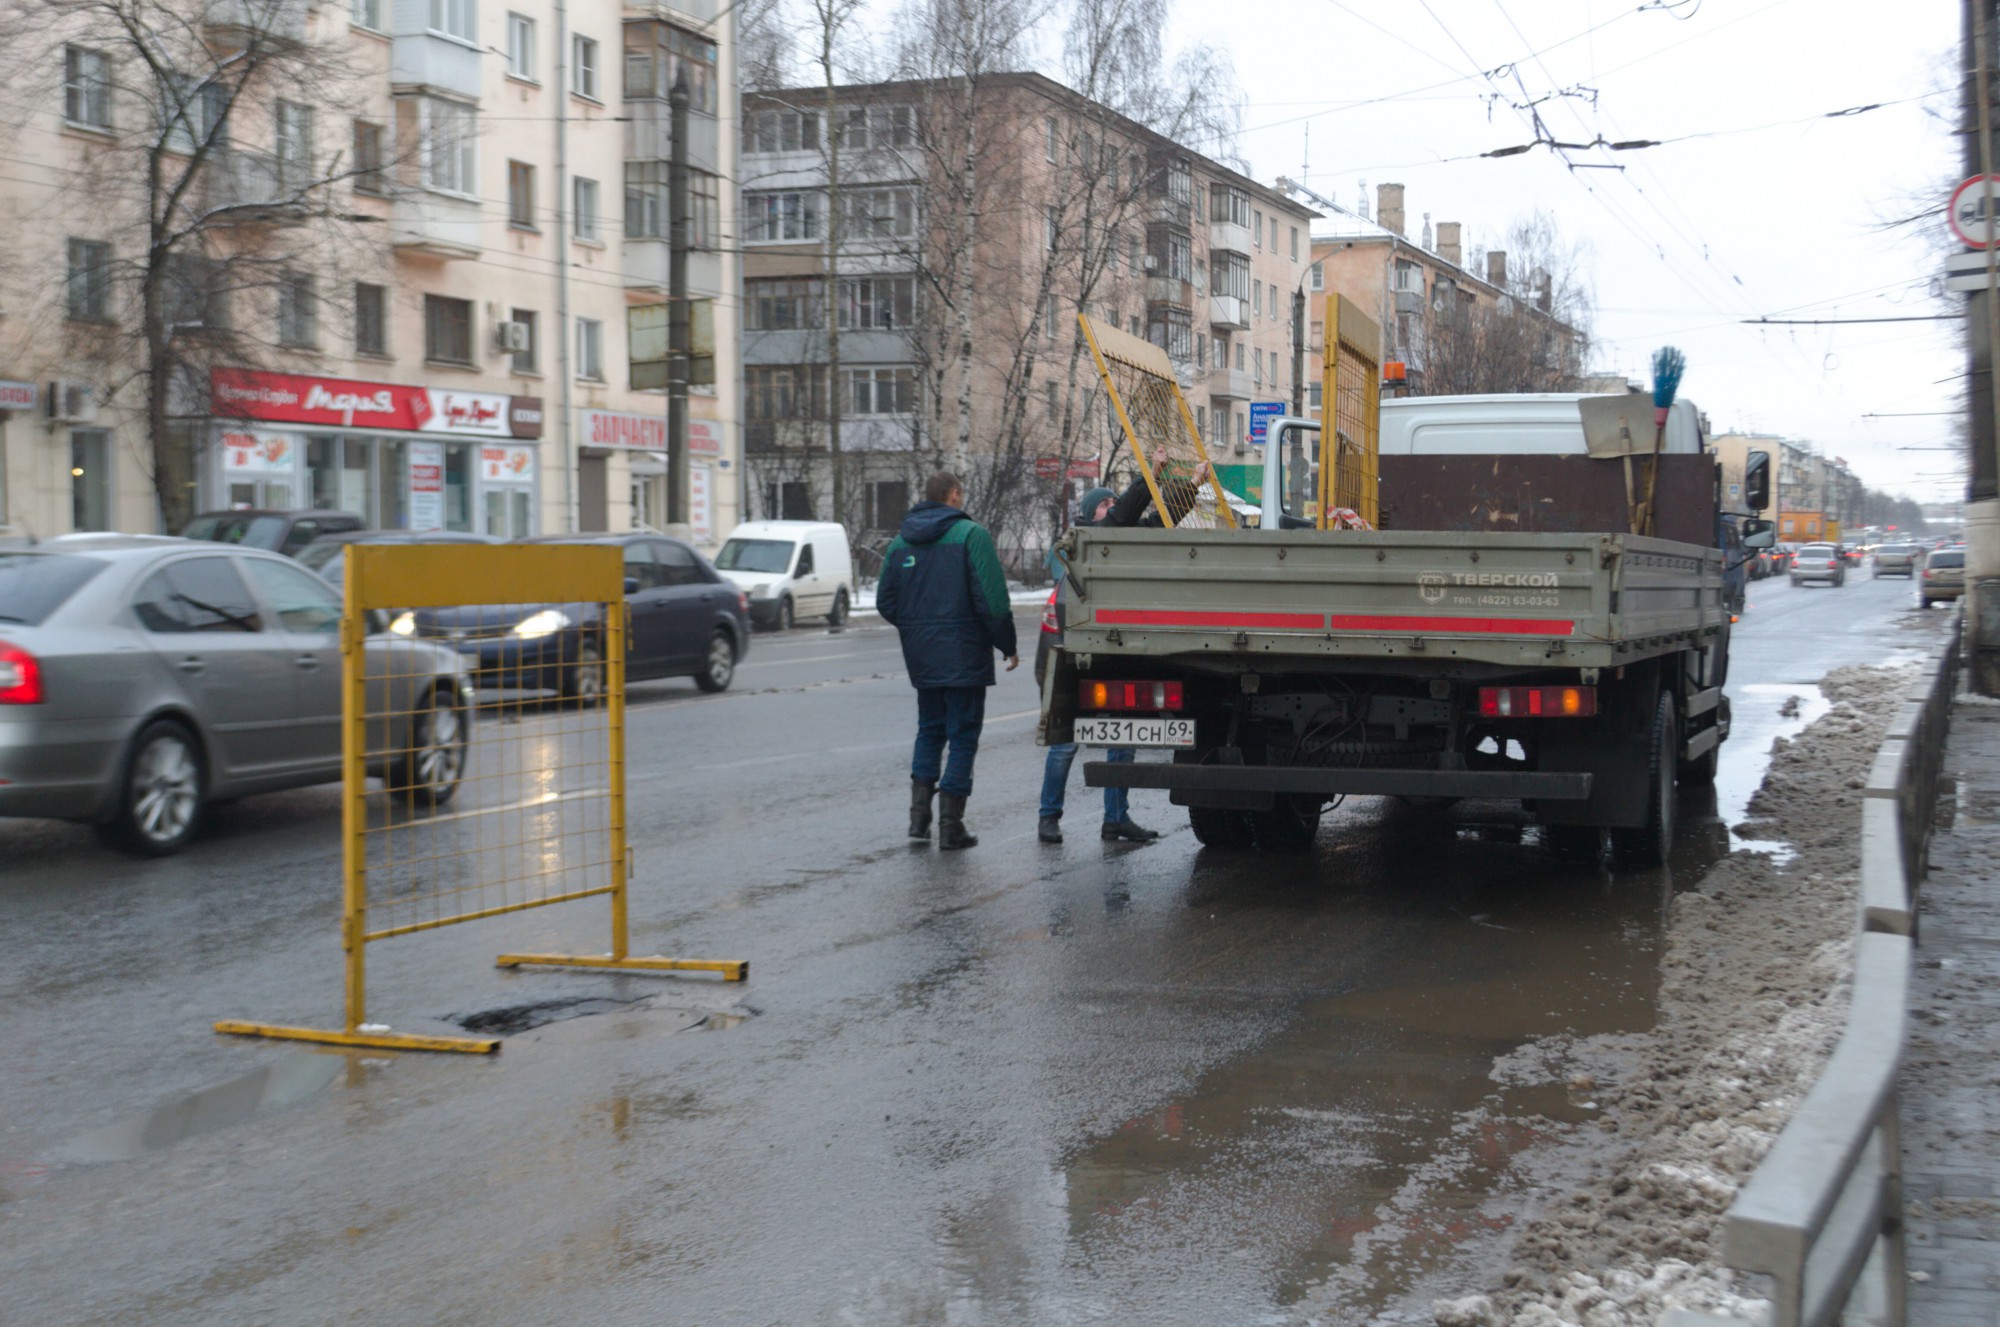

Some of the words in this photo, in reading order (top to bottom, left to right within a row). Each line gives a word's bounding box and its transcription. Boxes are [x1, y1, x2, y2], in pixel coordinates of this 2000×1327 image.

[591, 414, 665, 448] ЗАПЧАСТИ
[1452, 572, 1559, 587] ТВЕРСКОЙ
[1453, 597, 1475, 605] тел.
[1478, 595, 1510, 607] (4822)
[1513, 596, 1560, 607] 63-03-63
[1081, 721, 1161, 742] М331СН
[1168, 721, 1188, 737] 69
